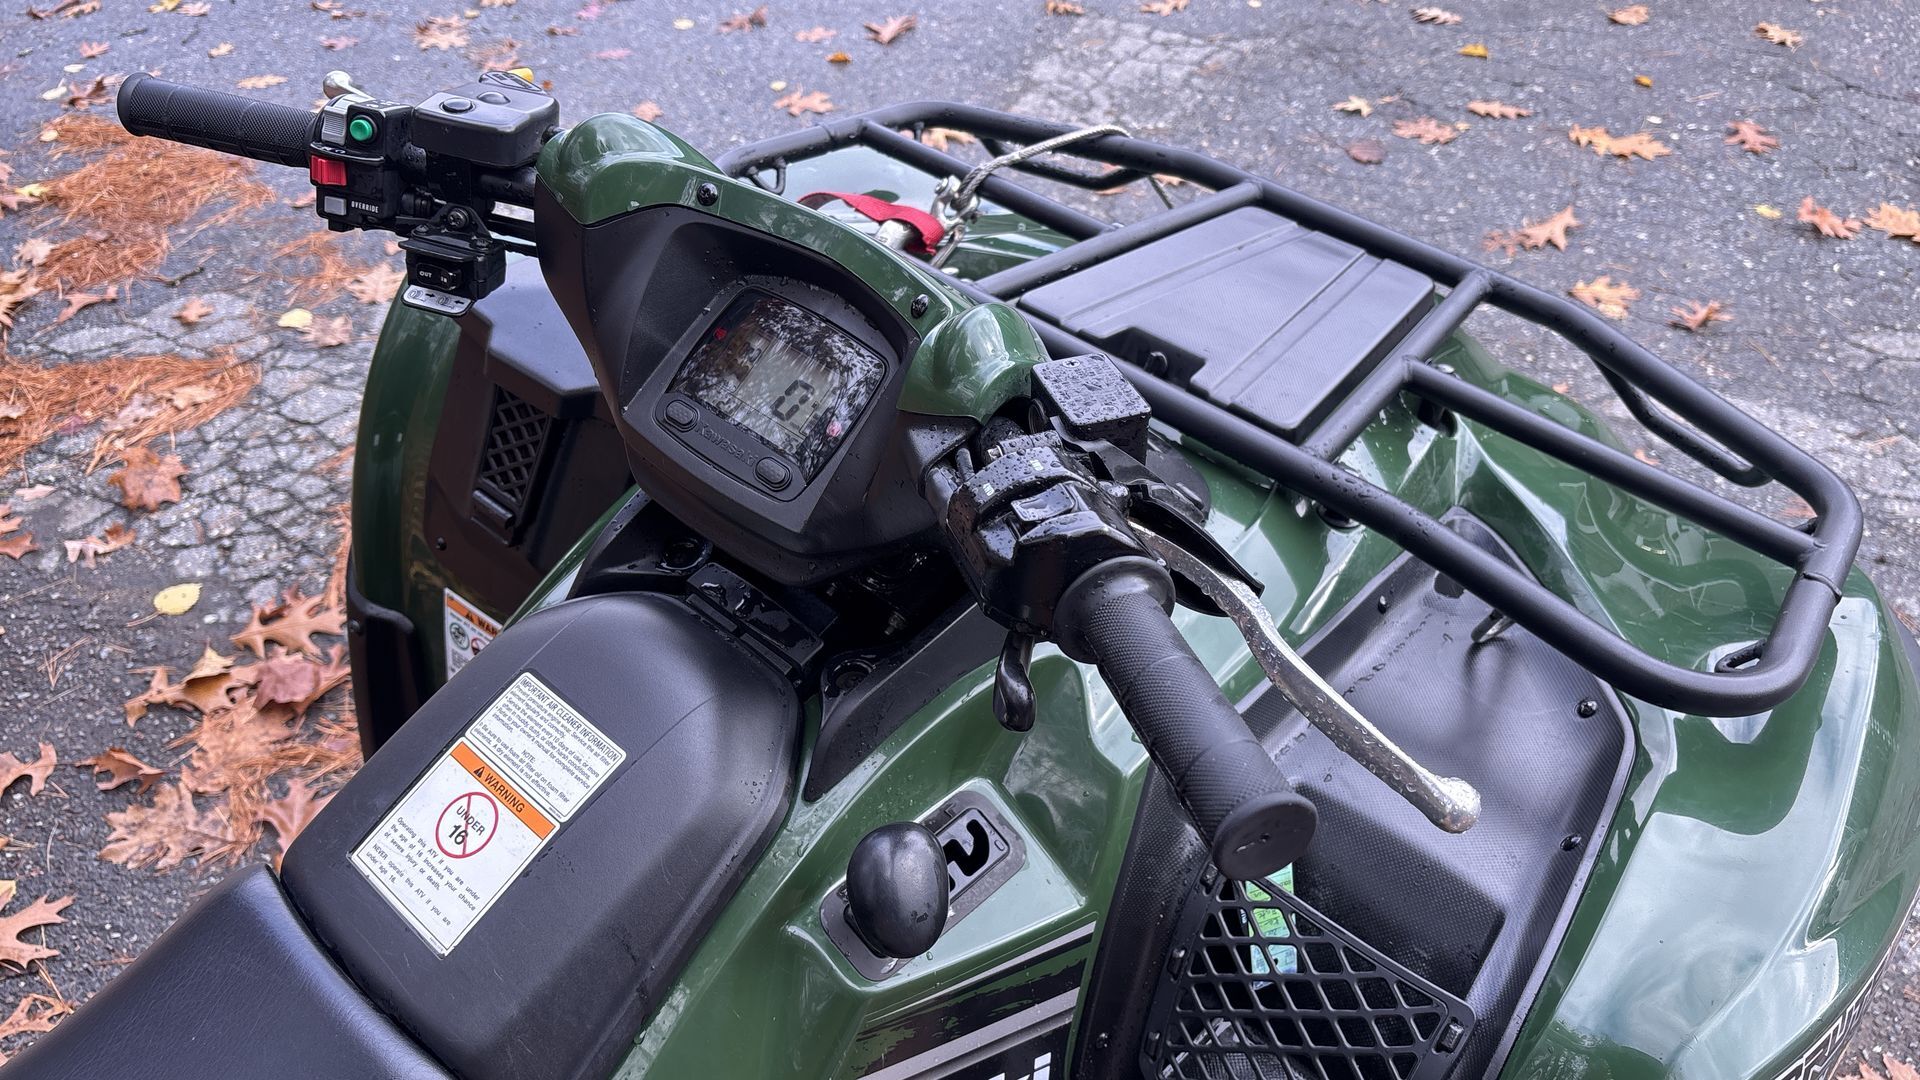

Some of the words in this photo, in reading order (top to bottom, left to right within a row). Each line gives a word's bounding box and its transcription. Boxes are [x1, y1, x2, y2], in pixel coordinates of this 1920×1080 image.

[351, 201, 379, 213] OVERRIDE
[419, 270, 432, 278] OUT
[694, 422, 759, 467] Kawasaki
[506, 697, 523, 711] Service
[540, 727, 554, 740] every
[556, 740, 571, 753] days
[586, 766, 600, 779] more
[519, 678, 551, 704] IMPORTANT
[546, 700, 559, 712] AIR
[555, 707, 583, 732] CLEANER
[578, 727, 620, 762] INFORMATION
[487, 730, 498, 740] sure
[507, 747, 522, 760] foam
[524, 761, 537, 774] filter
[545, 781, 561, 795] foam
[557, 791, 571, 804] filter
[497, 707, 509, 719] Refer
[510, 720, 521, 730] your
[519, 726, 537, 742] owner's
[533, 739, 551, 755] manual
[553, 756, 577, 778] complete
[573, 773, 591, 790] service
[521, 749, 537, 764] NOTE:
[545, 739, 559, 751] other
[555, 748, 570, 761] harsh
[567, 758, 593, 781] conditions.
[570, 731, 589, 747] Service
[599, 755, 612, 767] filter
[483, 773, 527, 814] WARNING
[522, 770, 533, 781] not
[530, 777, 553, 798] effective.
[446, 822, 471, 847] 16
[455, 805, 487, 836] UNDER
[365, 850, 379, 865] under
[377, 865, 388, 876] age
[388, 874, 398, 885] 16.
[390, 838, 405, 854] severe
[404, 852, 419, 869] injury
[426, 874, 442, 891] death.
[390, 823, 400, 834] the
[398, 833, 409, 845] age
[423, 857, 446, 881] increases
[443, 880, 457, 894] your
[457, 892, 477, 912] chance
[395, 816, 419, 839] Operating
[417, 837, 428, 848] this
[427, 847, 439, 860] ATV
[443, 865, 455, 877] you
[465, 885, 481, 902] under
[372, 843, 389, 861] NEVER
[387, 859, 405, 879] operate
[404, 877, 415, 889] this
[414, 887, 426, 900] ATV
[430, 905, 442, 918] you
[441, 916, 452, 927] are
